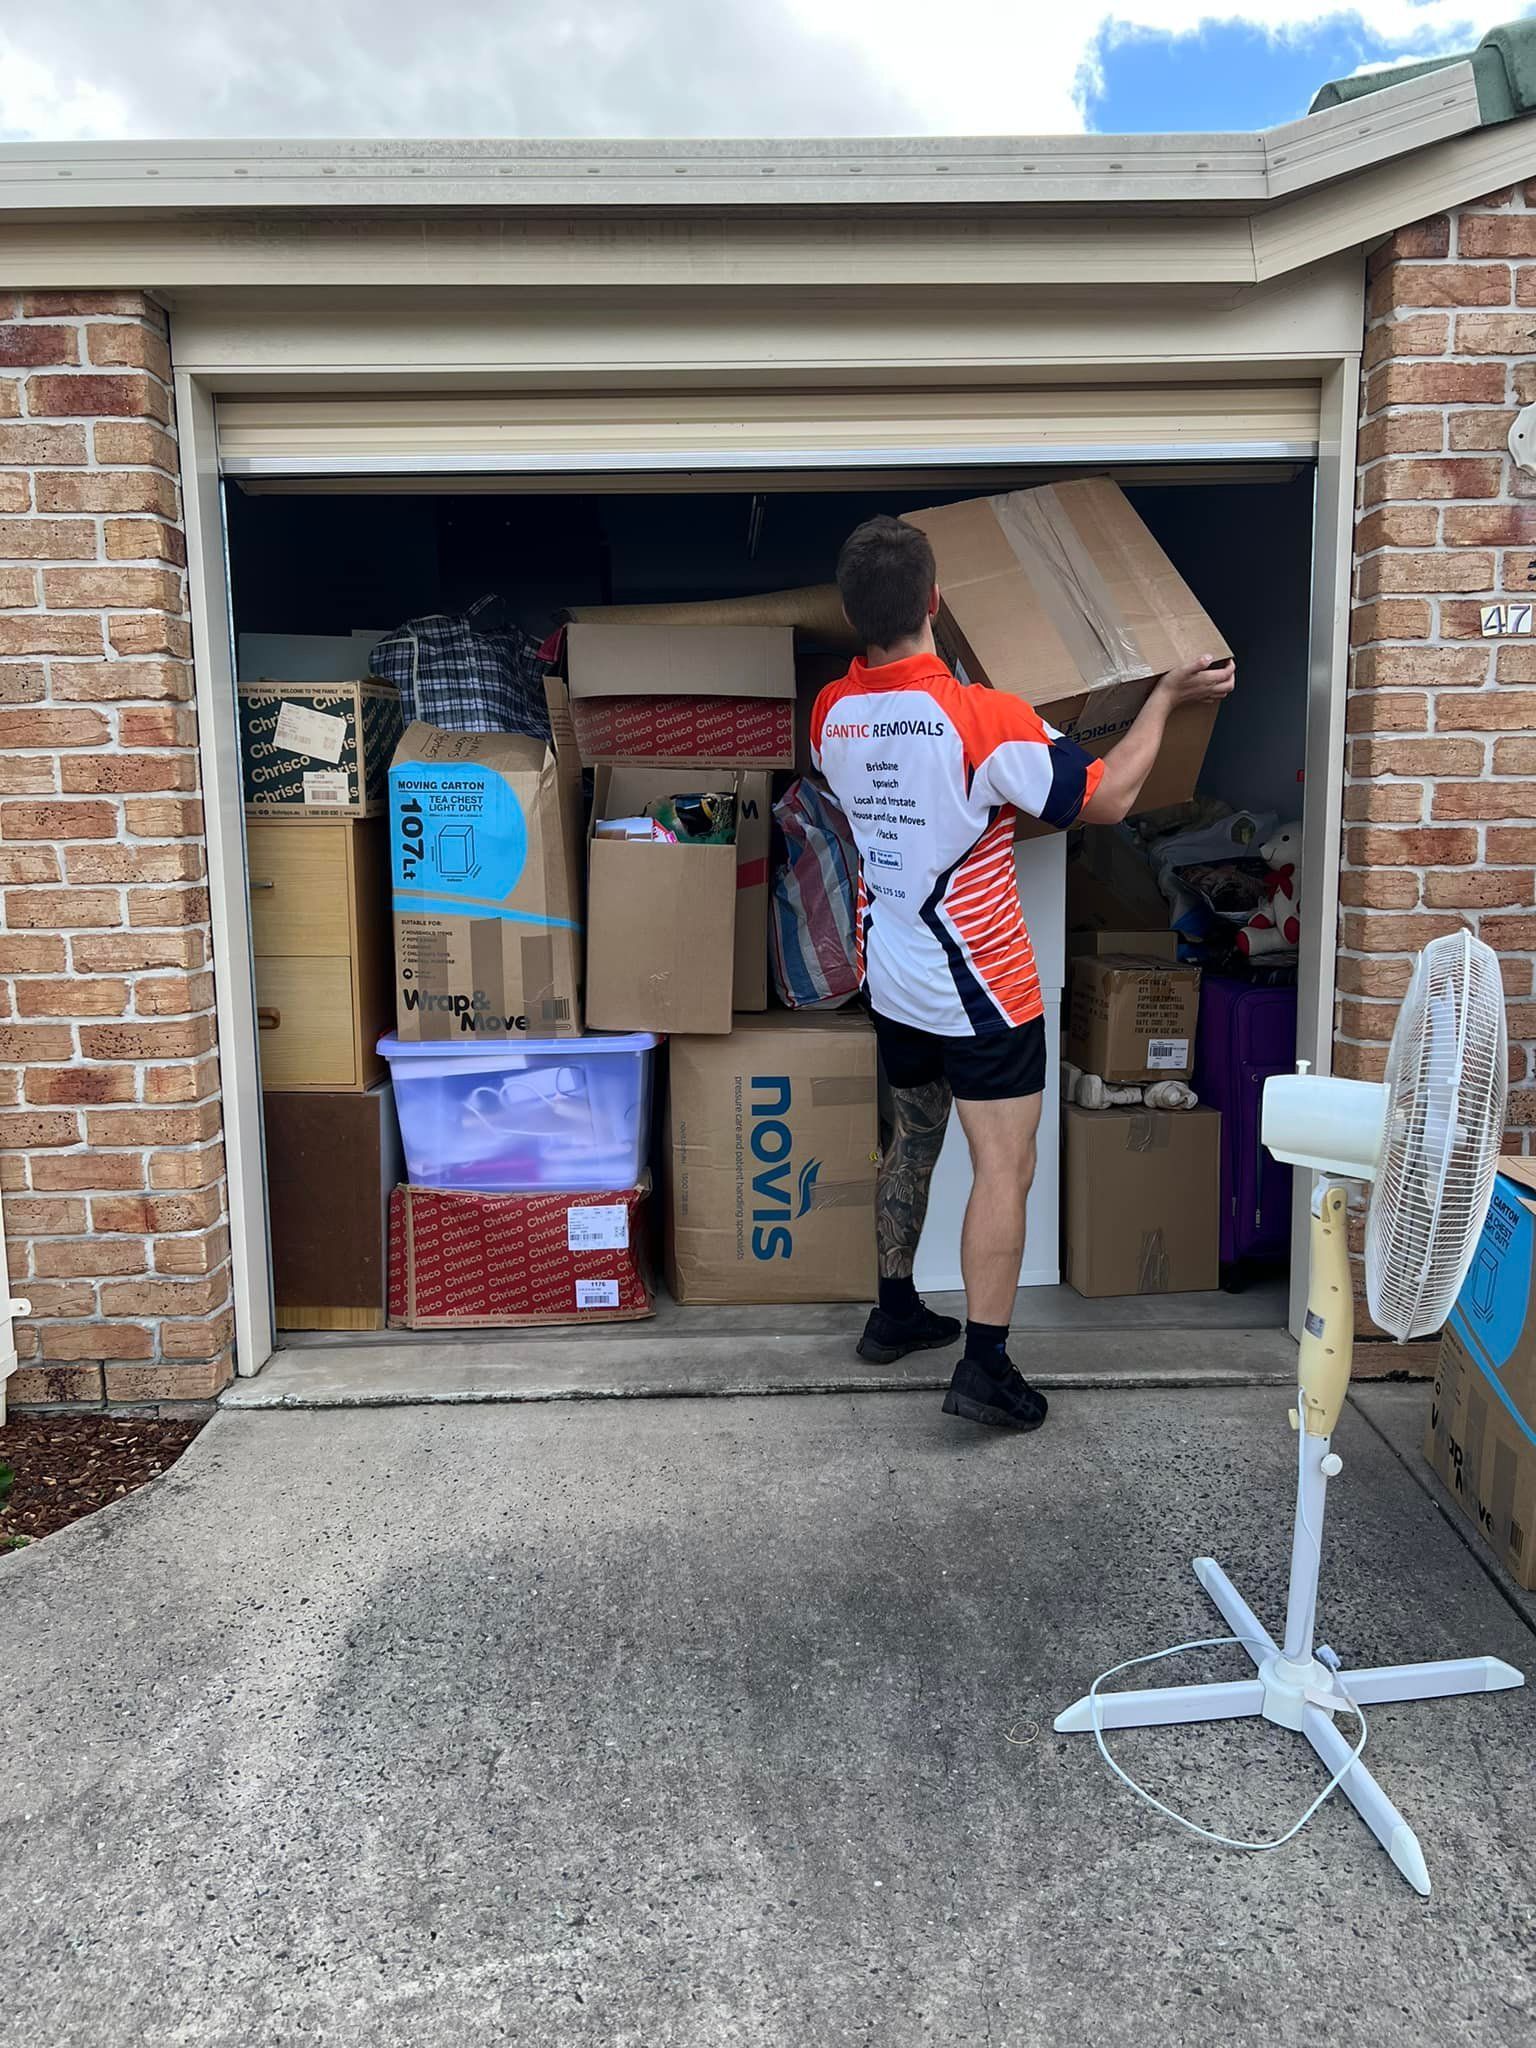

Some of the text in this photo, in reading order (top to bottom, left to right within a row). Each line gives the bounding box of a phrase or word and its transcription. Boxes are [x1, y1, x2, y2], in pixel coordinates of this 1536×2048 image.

[1484, 605, 1531, 633] 47
[616, 710, 652, 728] Chrisco
[656, 710, 692, 728] Chrisco
[696, 711, 733, 728] Chrisco
[736, 712, 772, 728] Chrisco
[616, 726, 652, 743] Chrisco
[656, 726, 692, 744] Chrisco
[696, 726, 734, 744] Chrisco
[736, 726, 772, 744] Chrisco
[826, 720, 944, 738] GANTIC REMOVALS
[616, 740, 652, 757] Chrisco
[656, 741, 692, 757] Chrisco
[697, 742, 734, 757] Chrisco
[736, 742, 772, 757] Chrisco
[251, 756, 310, 783] Chrisco
[253, 783, 304, 803] Chrisc
[398, 780, 485, 791] MOVING CARTON
[429, 795, 484, 804] TEA CHEST
[429, 804, 484, 812] LIGHT DUTY
[854, 795, 874, 805] Local
[873, 811, 886, 822] and
[899, 815, 926, 827] Moves
[400, 797, 425, 881] 107Lt
[882, 886, 893, 896] 175
[894, 889, 906, 899] 150
[460, 1012, 530, 1032] Move
[735, 1076, 743, 1113] pressure
[737, 1134, 745, 1149] and
[735, 1152, 745, 1180] patient
[750, 1076, 793, 1261] novis
[440, 1196, 478, 1210] Chrisco
[735, 1183, 745, 1218] handling
[441, 1210, 478, 1226] Chrisco
[484, 1210, 522, 1228] Chrisco
[528, 1208, 567, 1228] Chrisco
[1494, 1195, 1520, 1226] CARTON
[442, 1225, 480, 1241] Chrisco
[485, 1226, 523, 1242] Chrisco
[528, 1224, 568, 1243] Chrisco
[1494, 1218, 1513, 1240] CHEST
[443, 1240, 481, 1256] Chrisco
[735, 1220, 744, 1260] specialists
[1494, 1230, 1510, 1251] DUTY
[486, 1241, 524, 1257] Chrisco
[529, 1240, 568, 1258] Chrisco
[444, 1255, 482, 1272] Chrisco
[488, 1256, 525, 1272] Chrisco
[530, 1256, 568, 1273] Chrisco
[574, 1254, 613, 1273] Chrisco
[445, 1270, 484, 1287] Chrisco
[488, 1271, 526, 1287] Chrisco
[531, 1270, 570, 1288] Chrisco
[446, 1285, 484, 1302] Chrisco
[489, 1286, 527, 1302] Chrisco
[532, 1285, 571, 1302] Chrisco
[446, 1300, 485, 1317] Chrisco
[490, 1300, 528, 1316] Chrisco
[534, 1299, 572, 1314] Chrisco
